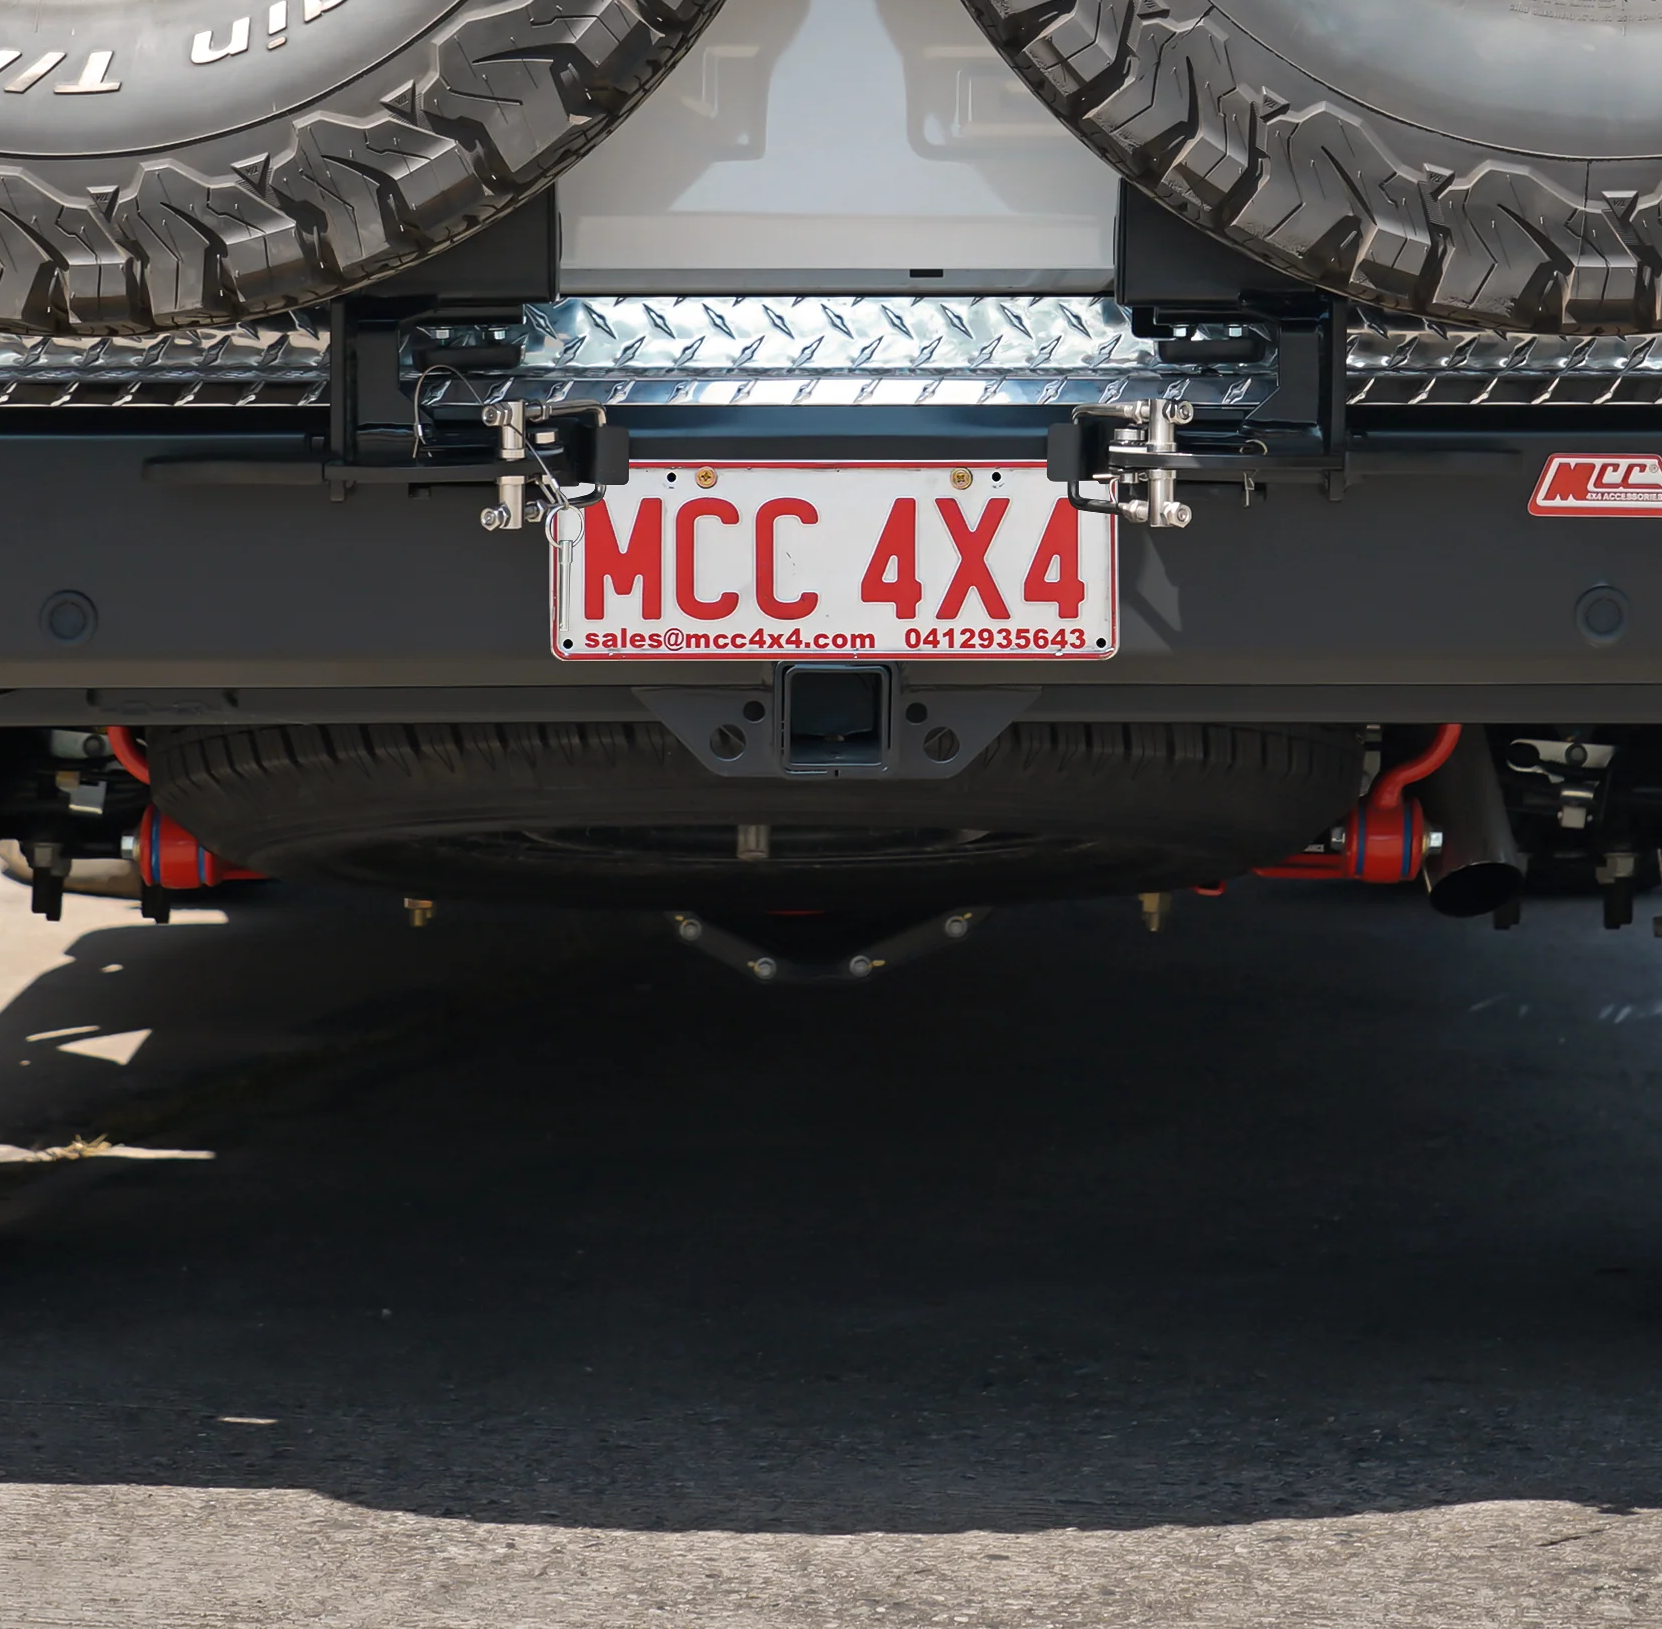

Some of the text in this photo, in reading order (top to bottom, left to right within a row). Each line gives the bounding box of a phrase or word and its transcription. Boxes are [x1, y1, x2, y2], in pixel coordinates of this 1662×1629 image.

[1542, 462, 1662, 501] MCC
[1586, 492, 1602, 501] 4X4
[584, 497, 1085, 621] MCC 4X4
[584, 627, 1086, 650] sales@mcc4x4.com 0412935643
